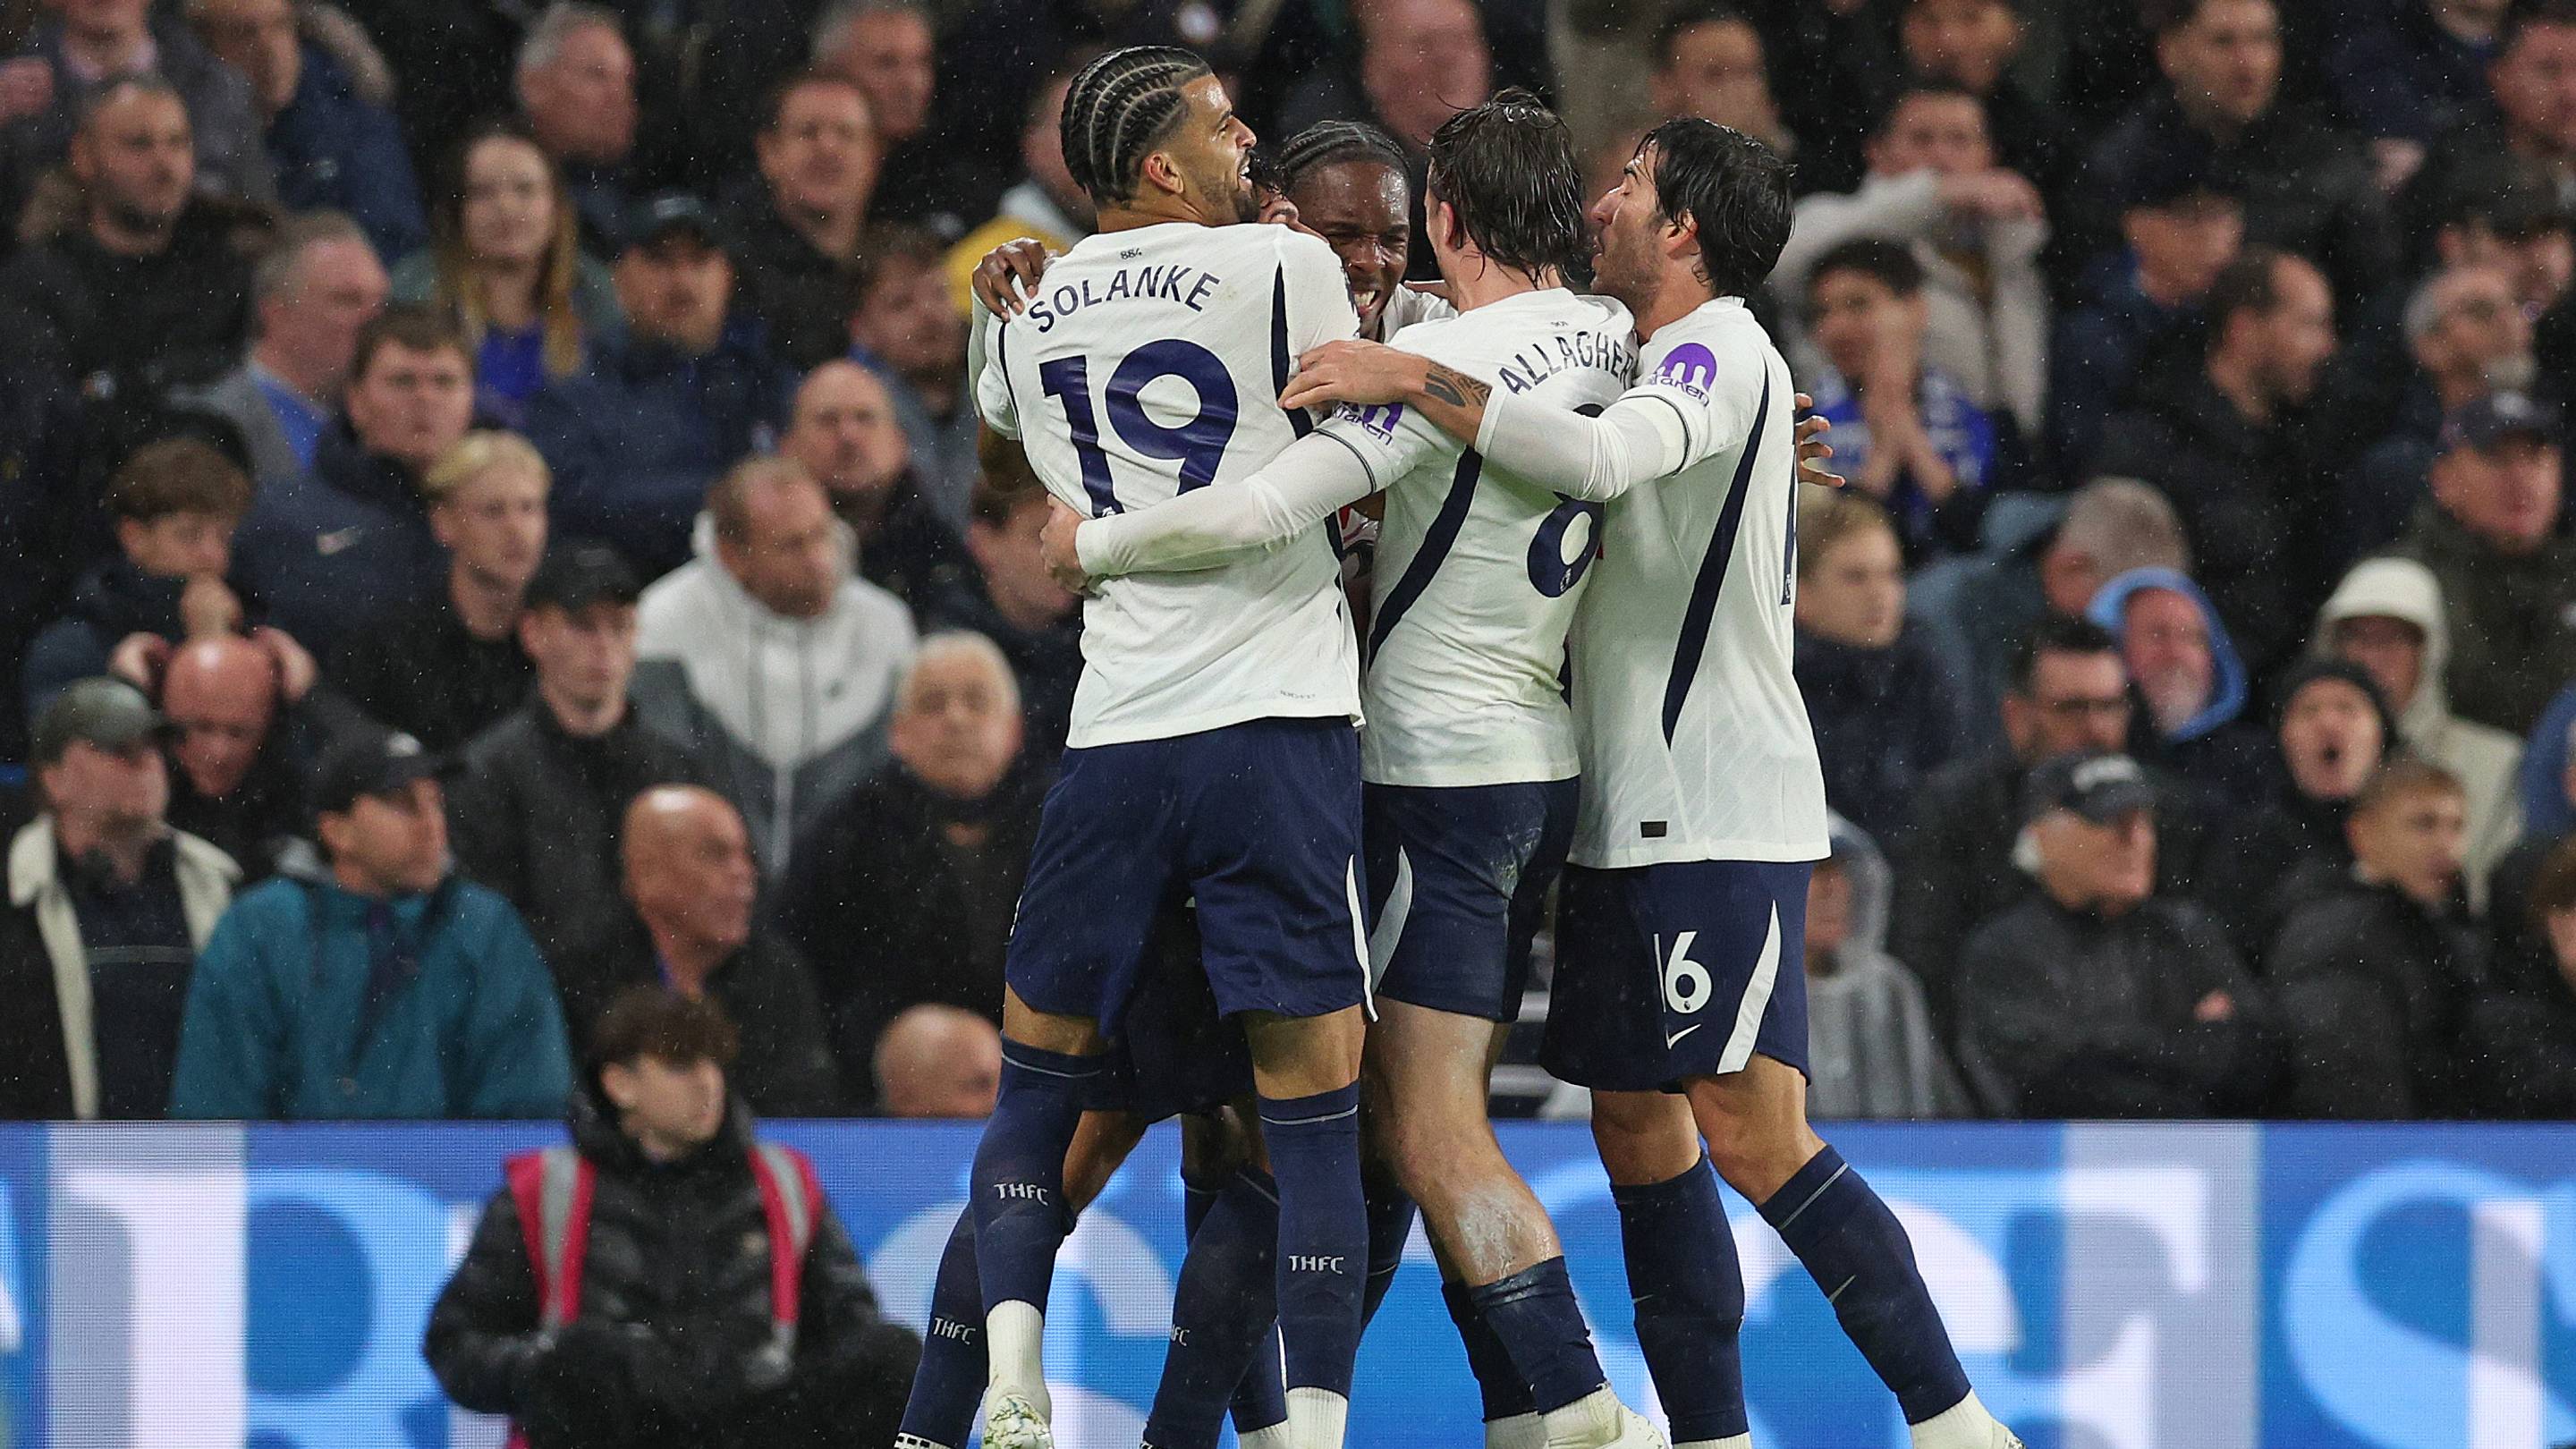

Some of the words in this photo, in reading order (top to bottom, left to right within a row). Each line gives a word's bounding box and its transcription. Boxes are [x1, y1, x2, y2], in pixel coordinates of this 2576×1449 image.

[1029, 265, 1220, 333] SOLANKE
[1498, 330, 1637, 395] ALLAGHER
[1038, 338, 1239, 519] 19
[993, 1182, 1048, 1207] THFC
[1288, 1255, 1344, 1275] THFC
[933, 1317, 977, 1345] THFC
[1171, 1324, 1191, 1346] FC
